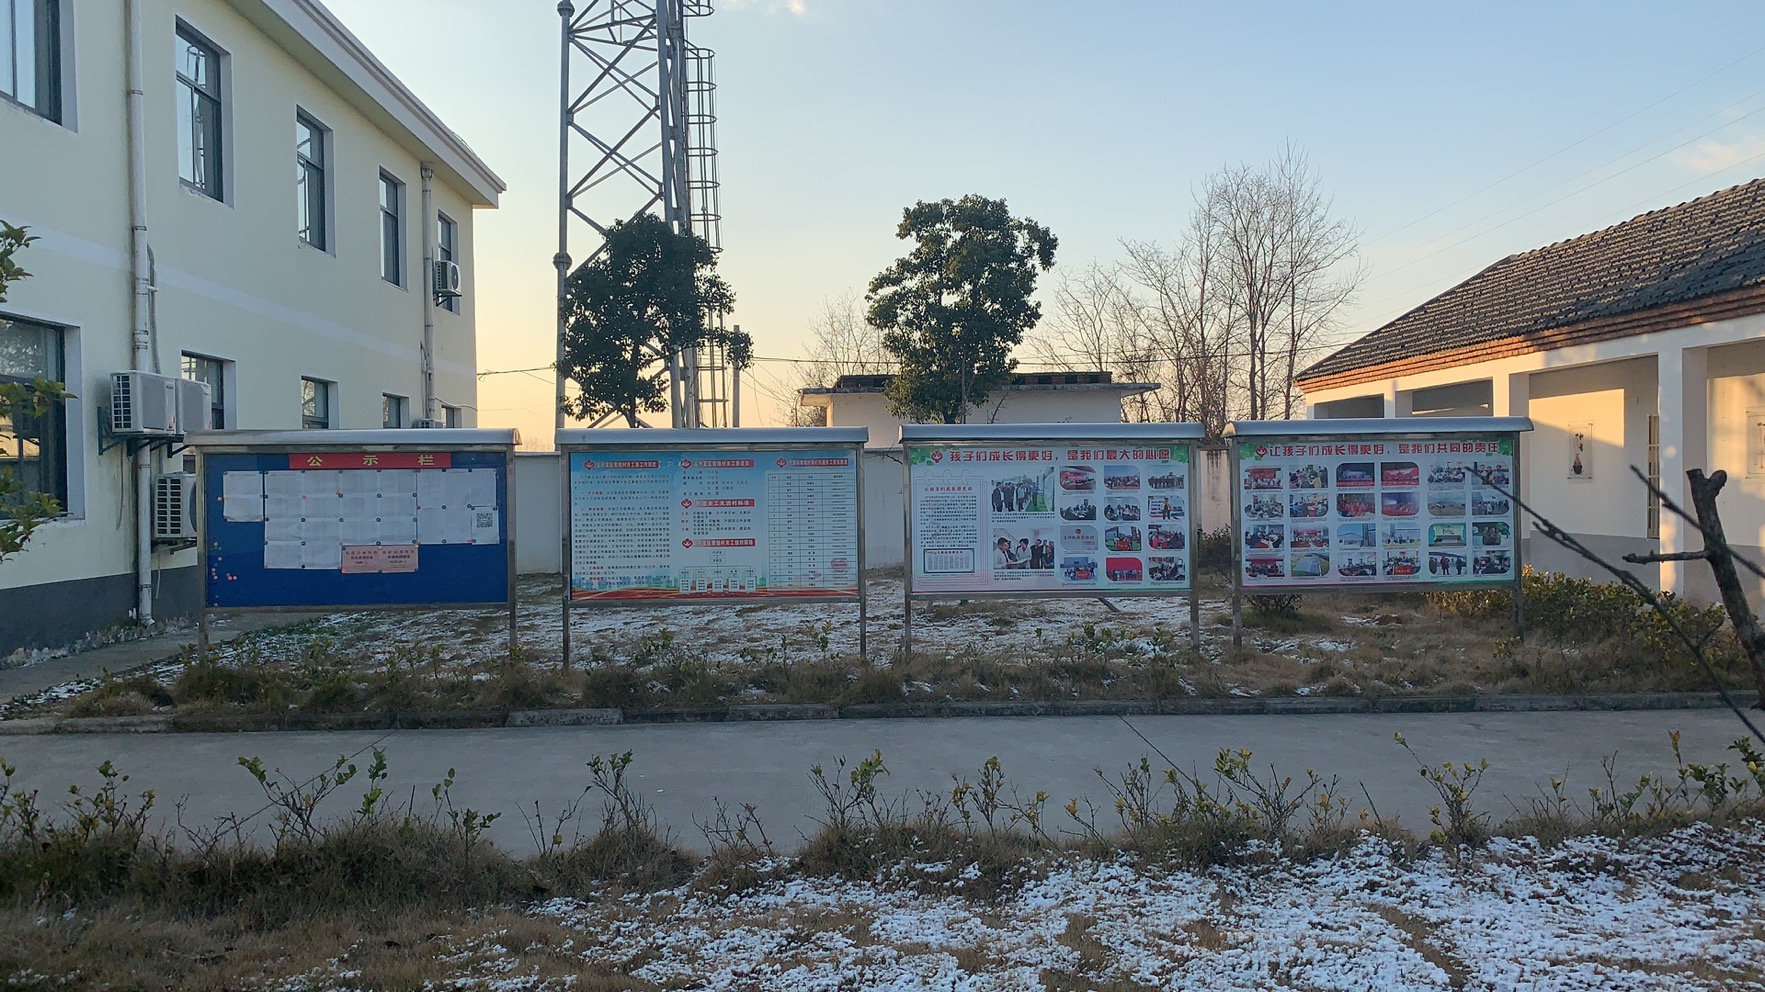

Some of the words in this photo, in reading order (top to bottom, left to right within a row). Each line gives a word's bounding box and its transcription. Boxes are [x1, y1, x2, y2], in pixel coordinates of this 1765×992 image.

[949, 448, 1171, 462] 孩子们成长得更好，是我们最大的心愿
[1269, 442, 1499, 457] 让孩子们成长得更好，是我们共同的责任
[307, 454, 434, 466] 公示栏
